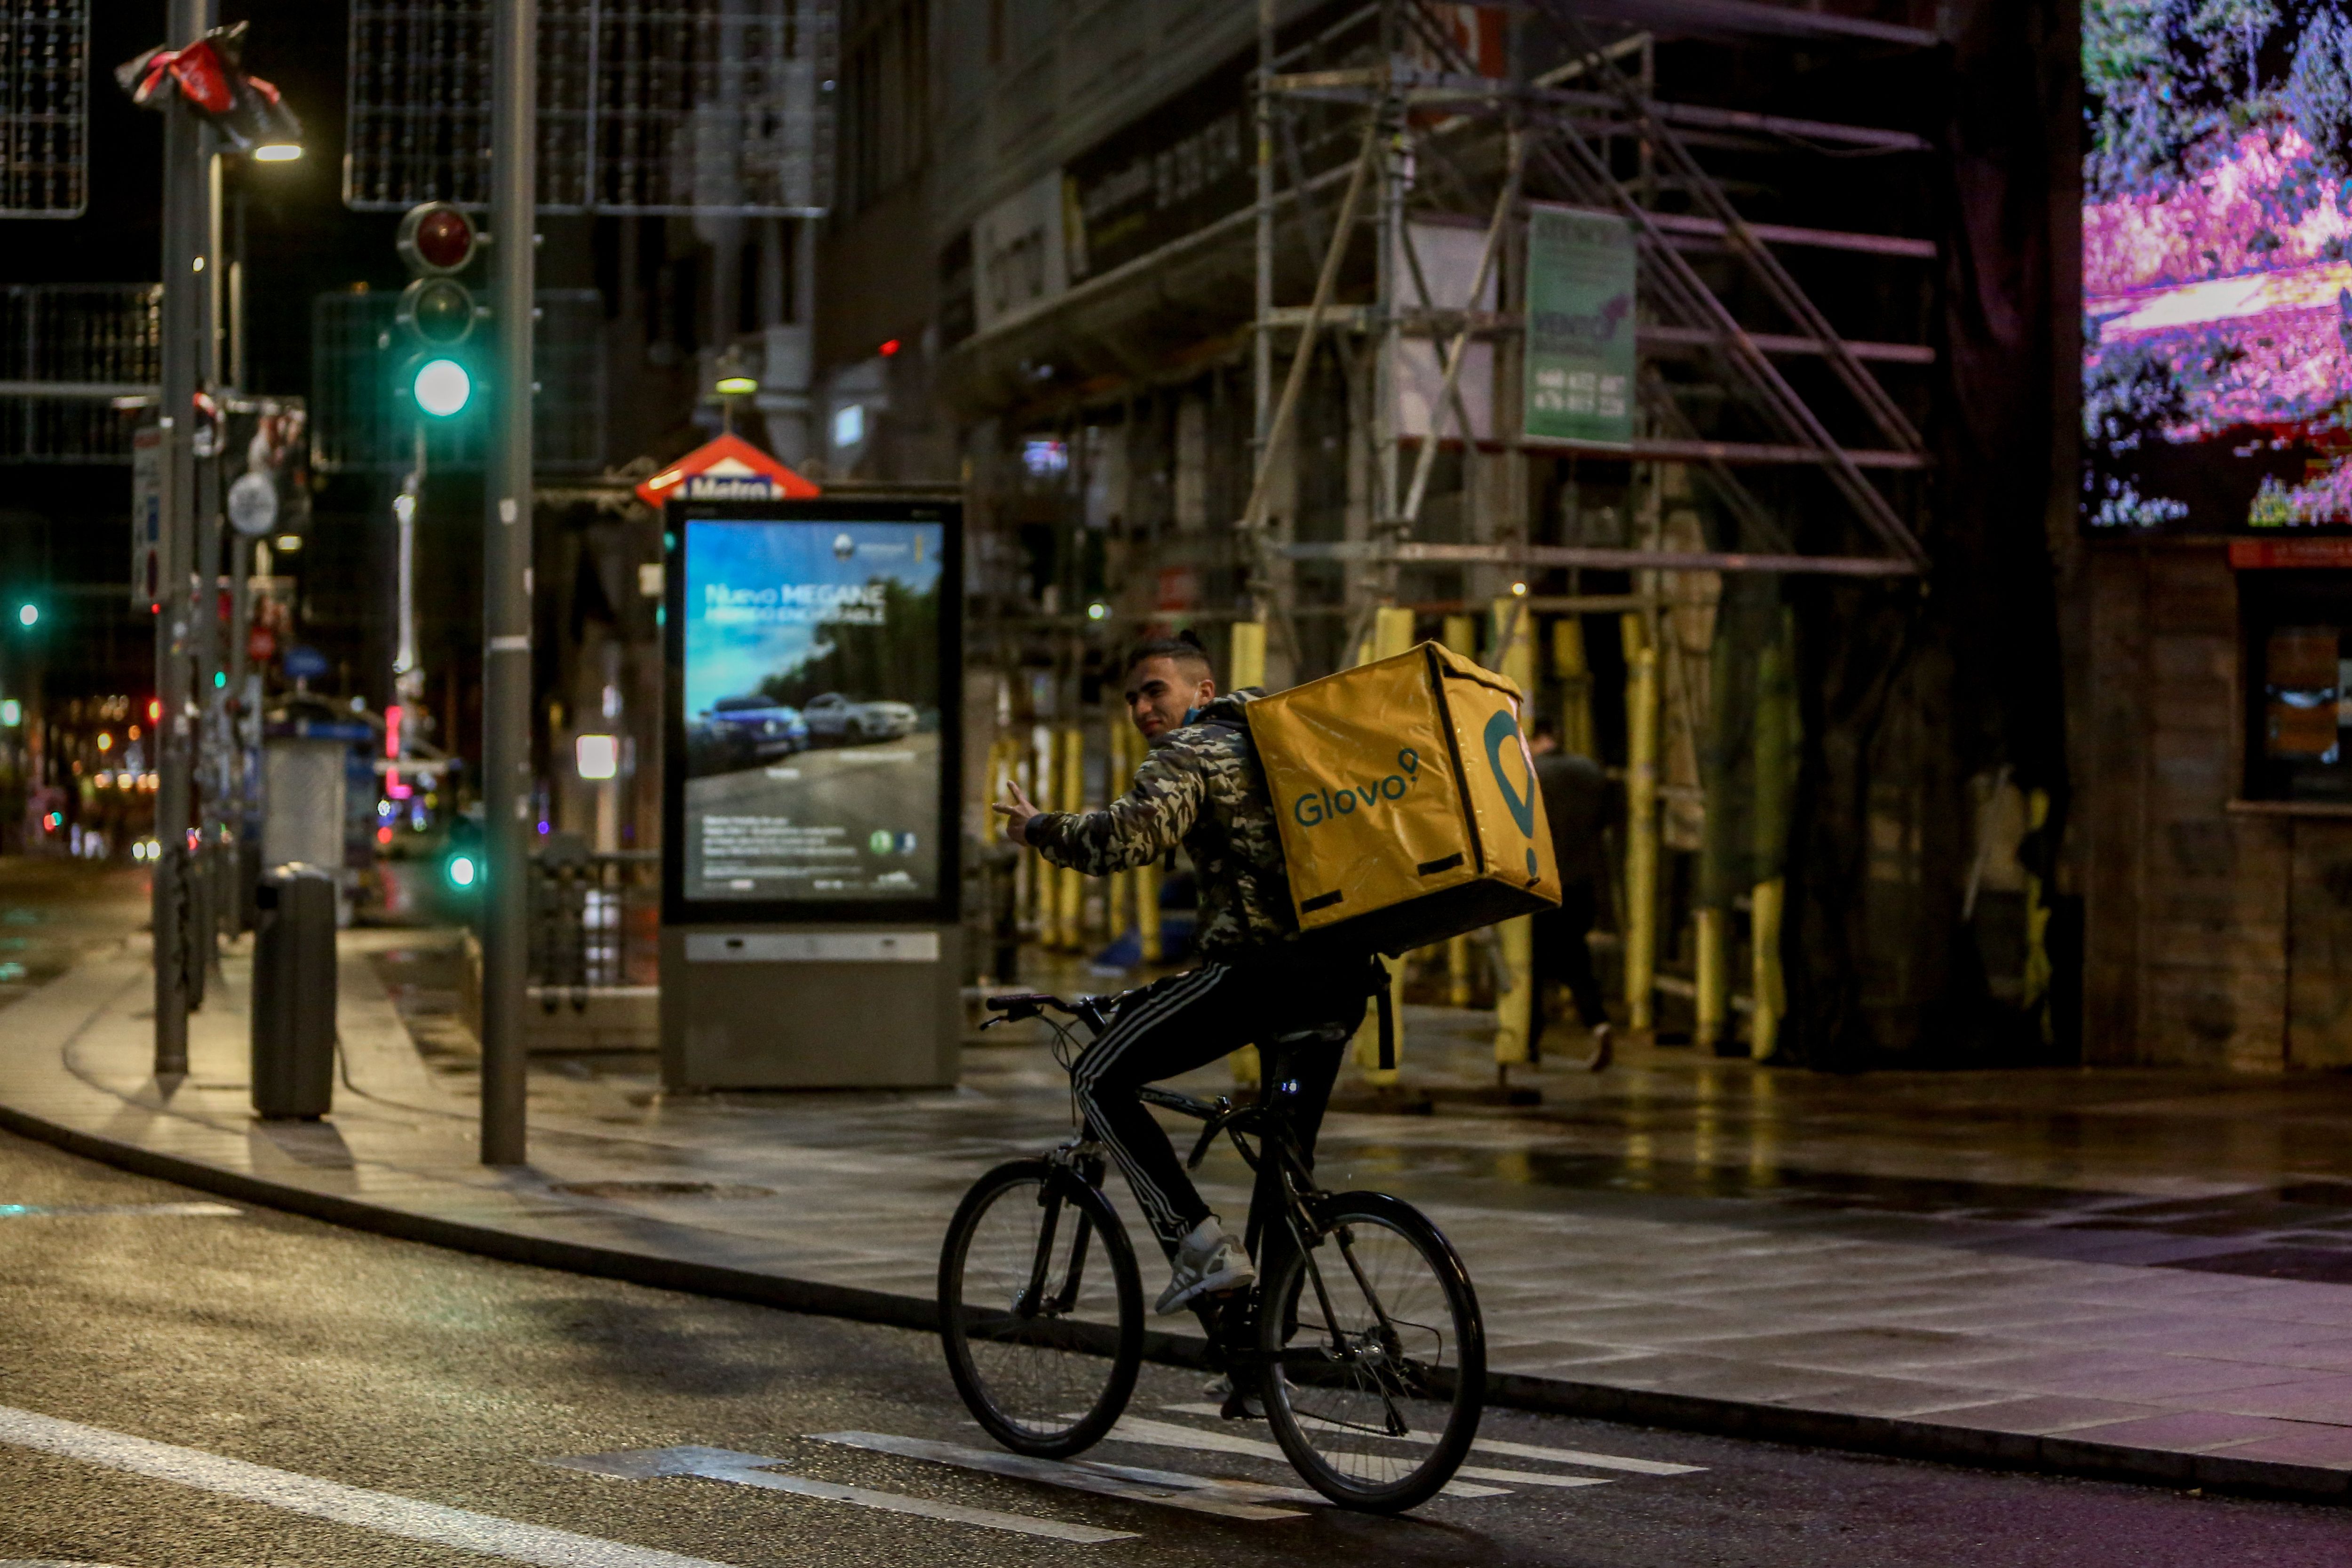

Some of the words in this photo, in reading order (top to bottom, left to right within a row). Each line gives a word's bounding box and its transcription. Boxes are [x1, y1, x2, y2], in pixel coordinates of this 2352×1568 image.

[690, 476, 769, 500] Metro
[704, 583, 779, 605] Nuevo
[1295, 774, 1406, 827] Glovo
